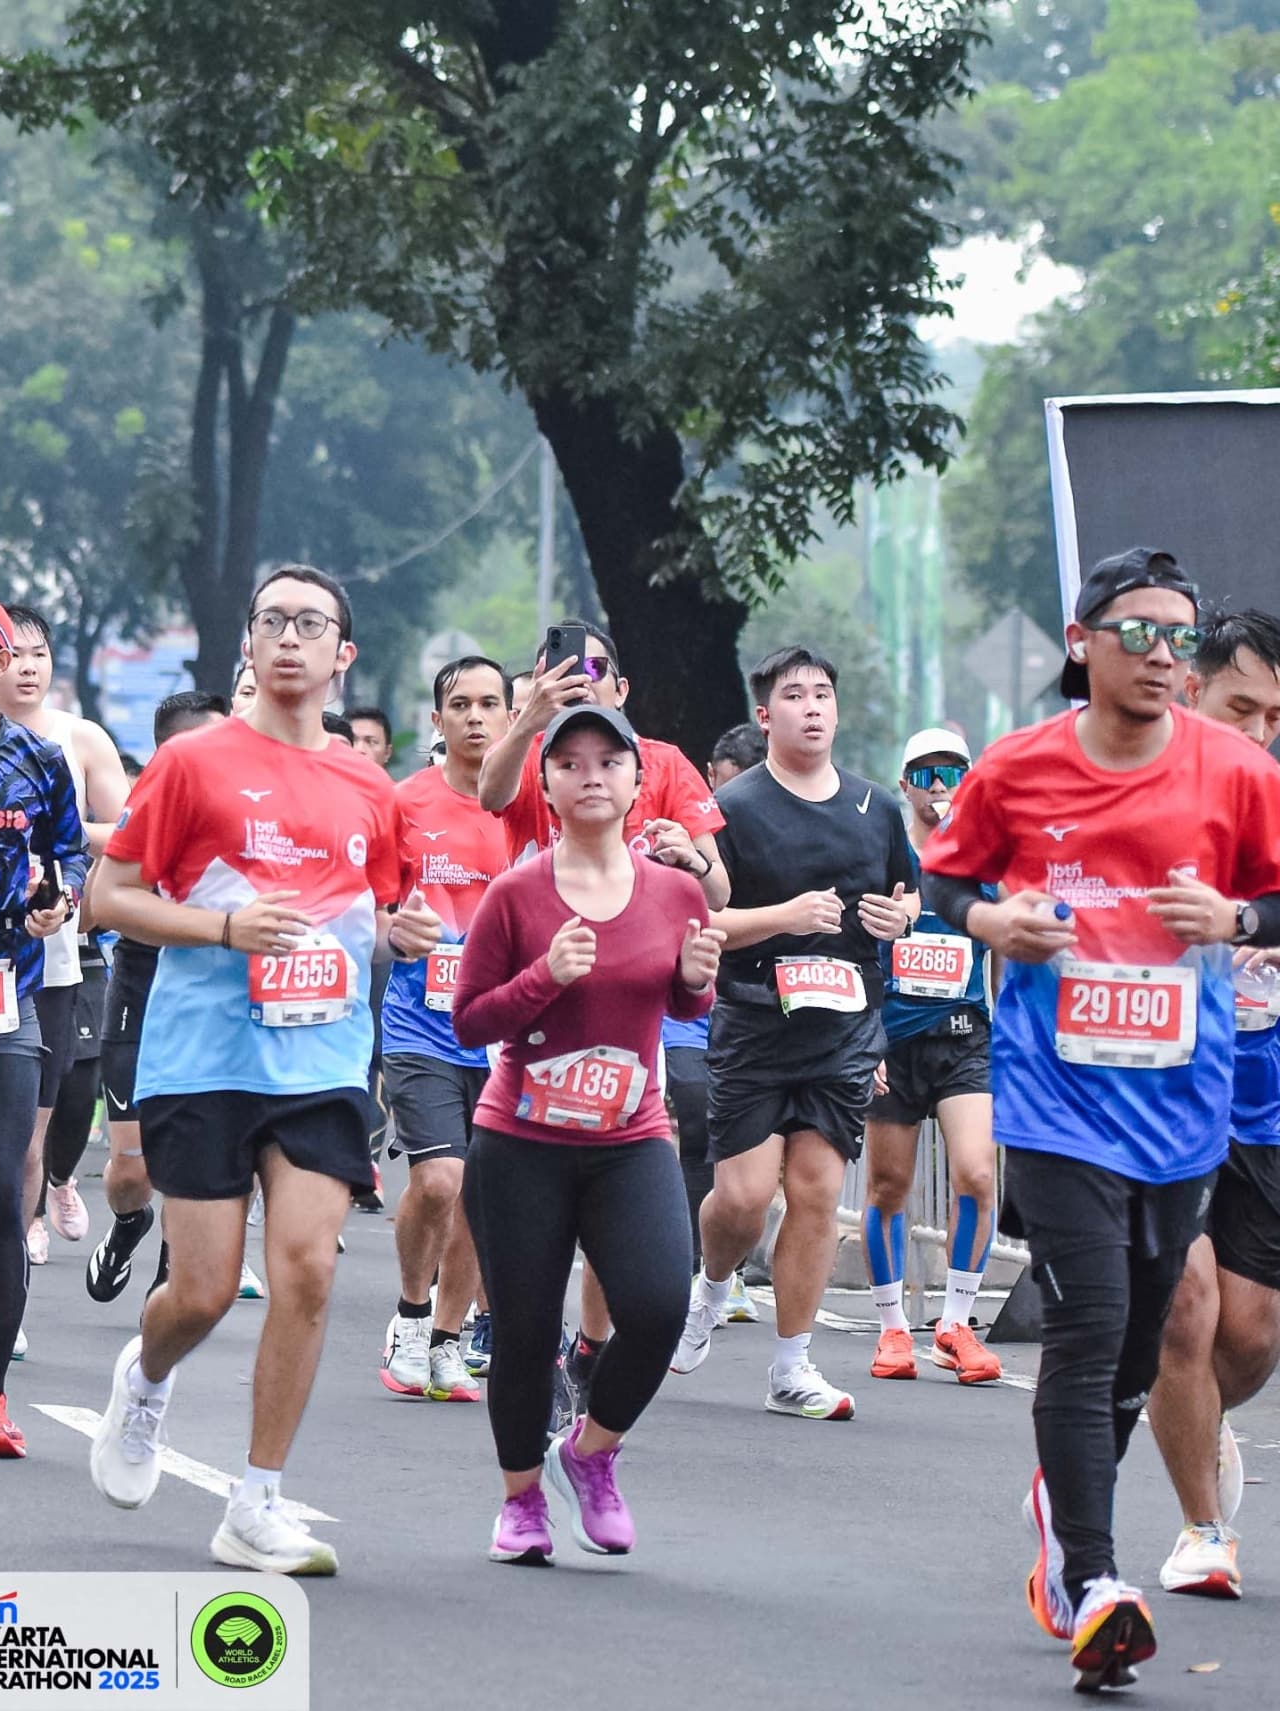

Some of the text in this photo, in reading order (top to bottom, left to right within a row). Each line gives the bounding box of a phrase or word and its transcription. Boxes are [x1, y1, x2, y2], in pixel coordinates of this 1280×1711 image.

[254, 843, 329, 859] INTERNATIONAL
[428, 863, 464, 872] JAKARTA
[428, 870, 492, 882] INTERNATIONAL
[1053, 877, 1107, 890] JAKARTA
[898, 946, 957, 974] 32685
[260, 953, 338, 990] 27555
[435, 958, 460, 985] 30
[785, 965, 848, 989] 34034
[1070, 984, 1170, 1028] 29190
[950, 1014, 973, 1029] HL
